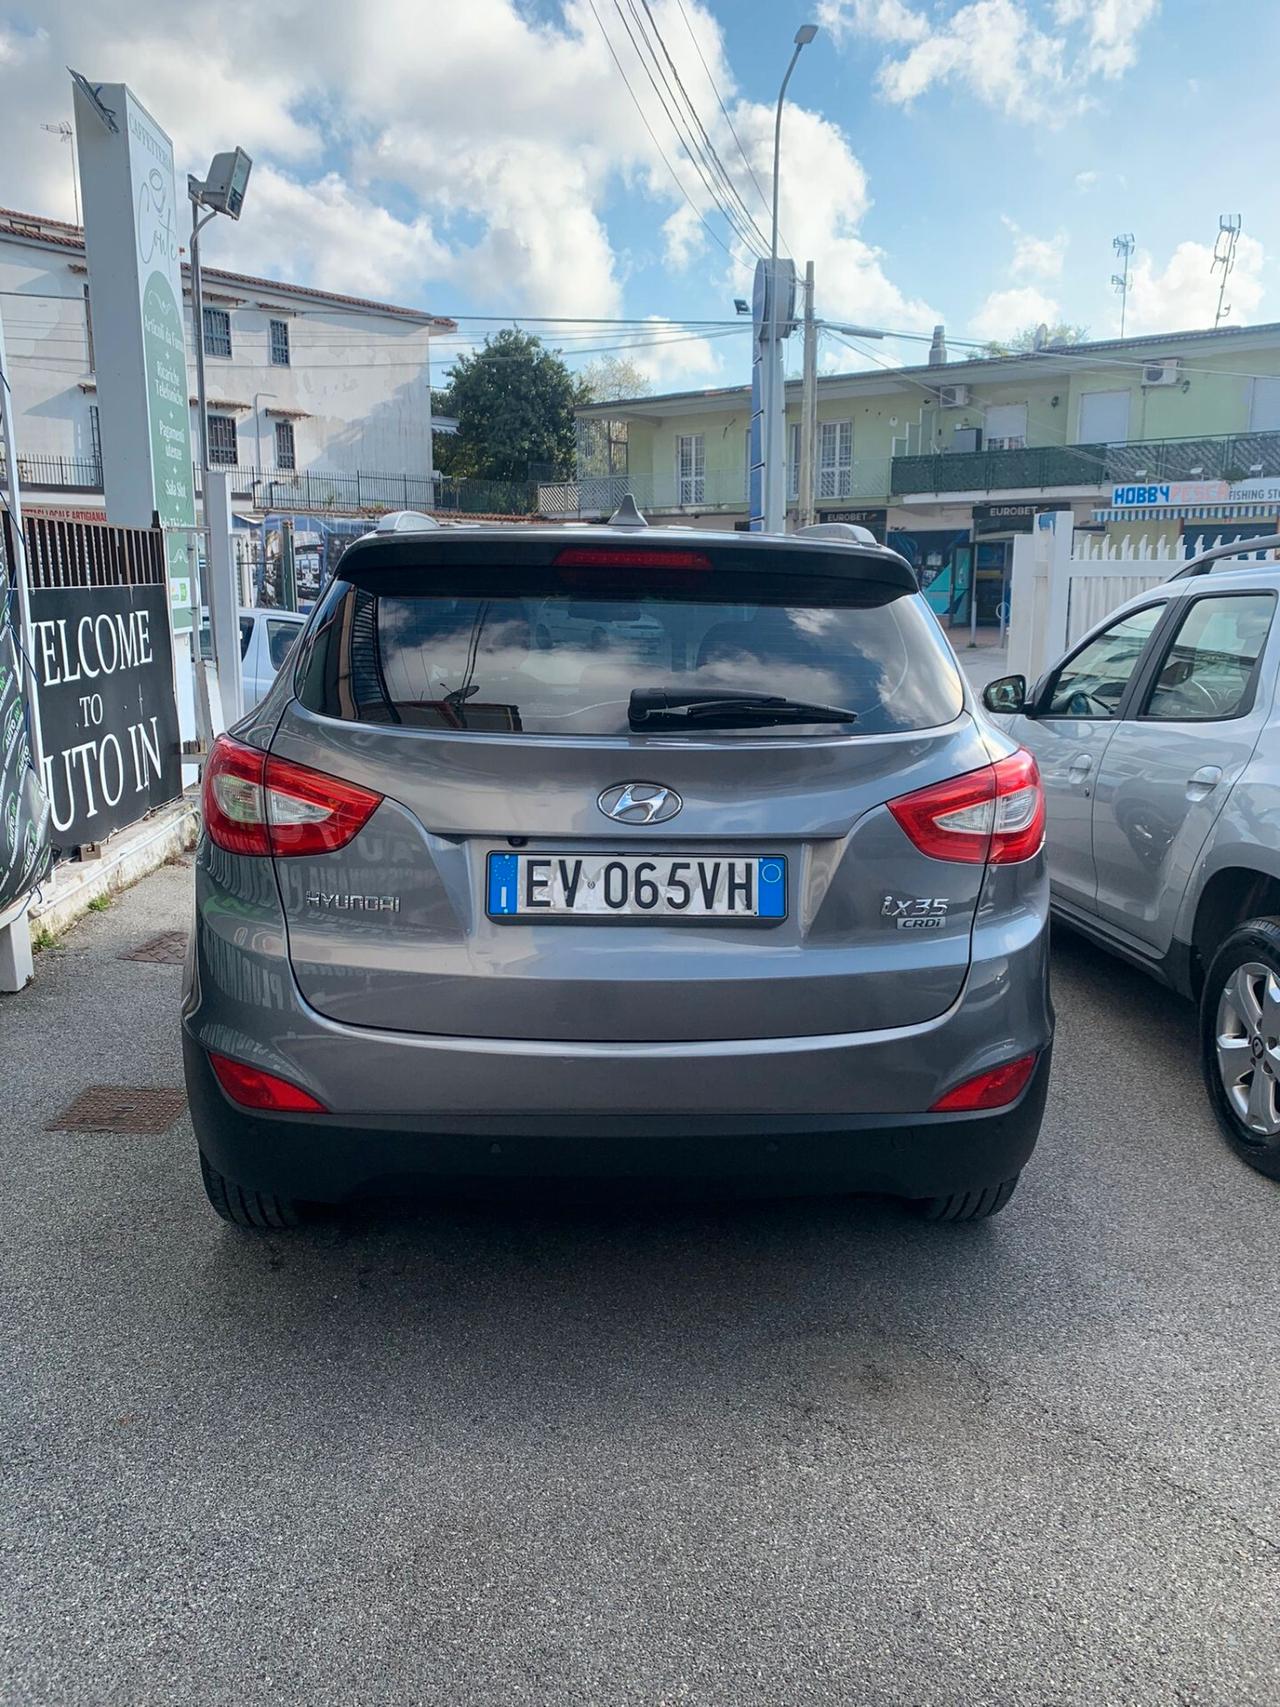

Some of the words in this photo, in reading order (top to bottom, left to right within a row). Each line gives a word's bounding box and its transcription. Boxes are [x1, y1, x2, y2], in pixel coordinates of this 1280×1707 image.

[1114, 485, 1171, 505] HOBBY
[1229, 488, 1264, 501] FISHING
[827, 512, 867, 523] EUROBET
[989, 505, 1038, 517] EUROBET
[79, 692, 104, 729] TO
[43, 732, 125, 833] UTO
[128, 716, 164, 793] IN
[525, 859, 583, 908] EV
[306, 890, 401, 913] HYUNDAI
[881, 896, 950, 917] ix35
[902, 918, 942, 928] CRDi
